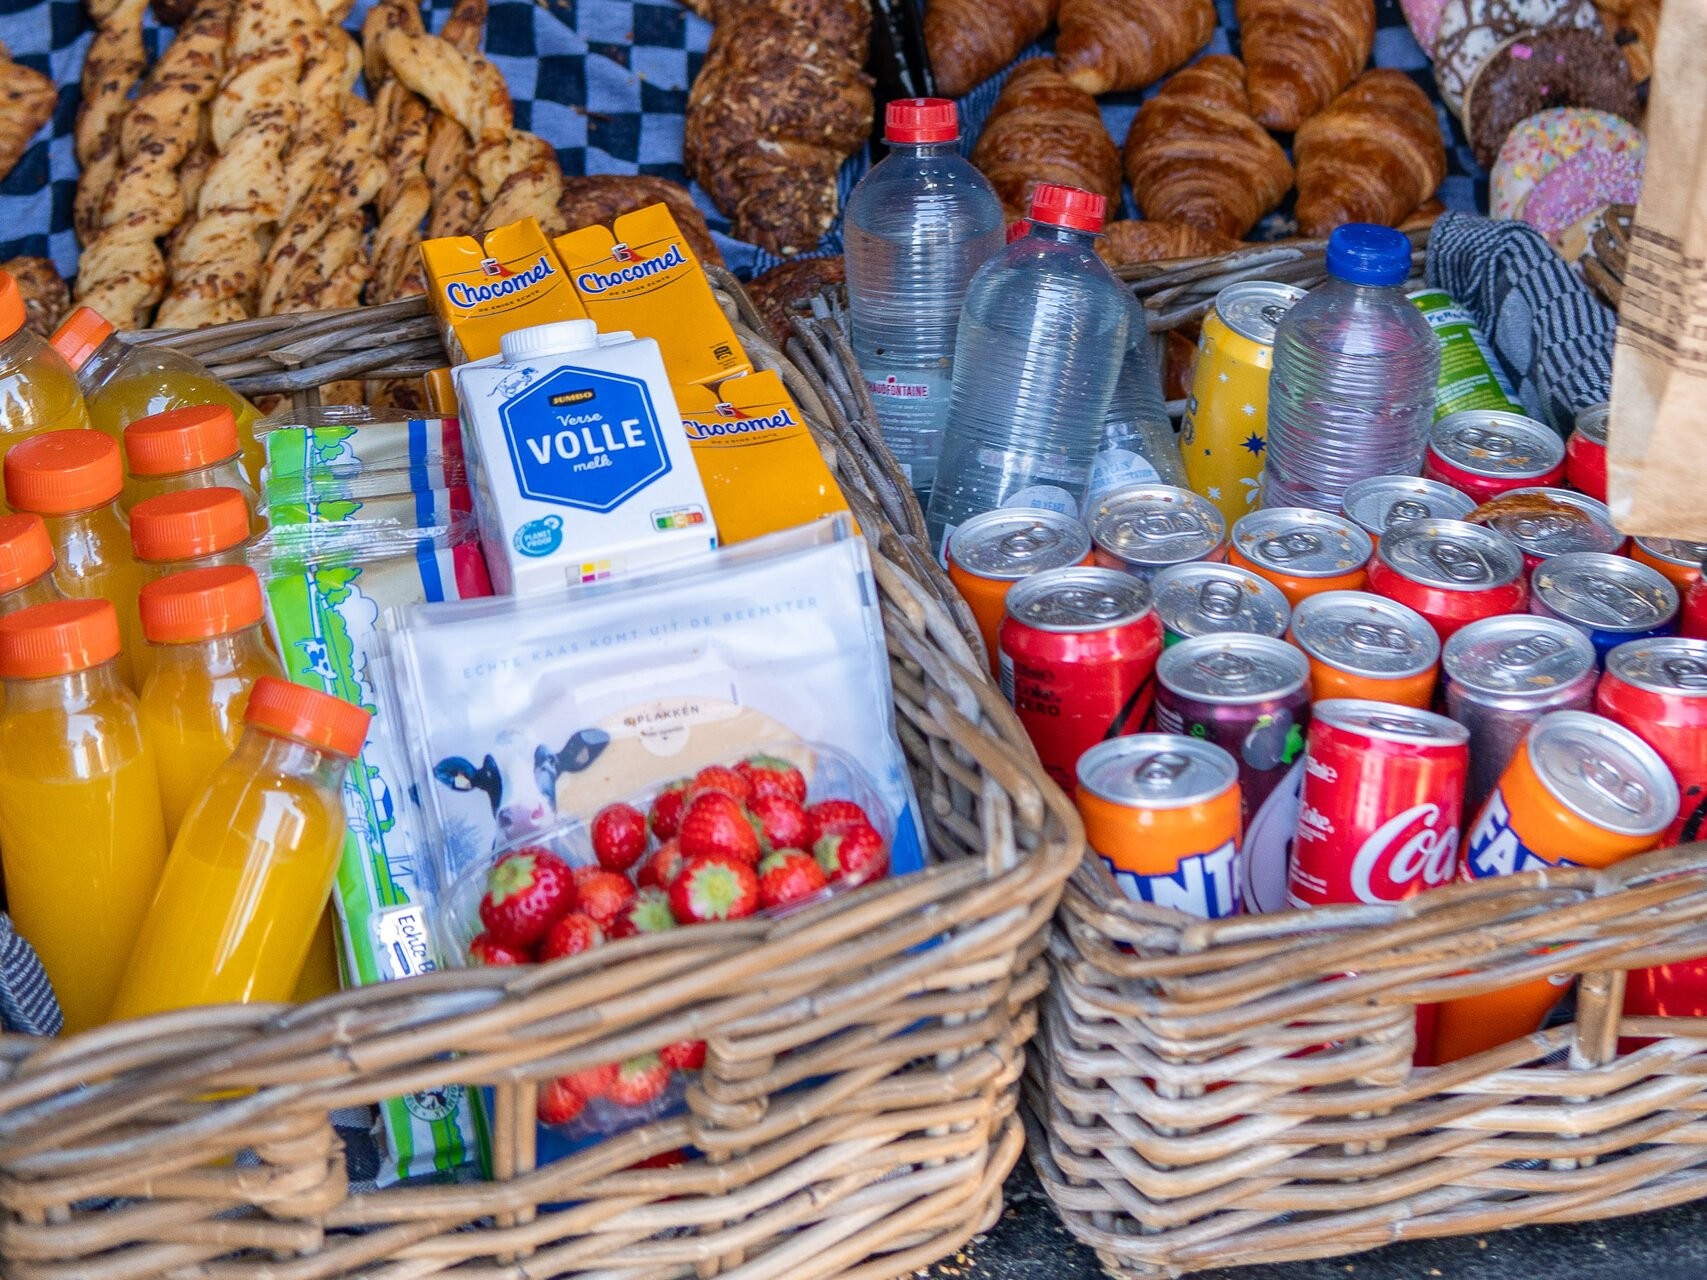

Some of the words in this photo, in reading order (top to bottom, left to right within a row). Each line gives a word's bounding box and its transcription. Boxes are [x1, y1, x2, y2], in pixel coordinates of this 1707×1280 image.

[446, 255, 556, 308] Chocomel
[577, 244, 688, 294] Chocomel
[552, 390, 595, 406] JUMBO
[555, 411, 604, 428] Verse
[682, 408, 798, 441] Chocomel
[525, 418, 647, 466] VOLLE
[572, 452, 614, 473] melk
[463, 657, 522, 680] ECHTE
[532, 640, 580, 661] KAAS
[590, 628, 639, 649] KOMT
[649, 622, 678, 636] UIT
[690, 615, 712, 629] DE
[722, 596, 818, 624] BEEMSTER
[636, 704, 699, 724] PLAKKEN
[397, 914, 428, 958] Echte
[418, 959, 438, 974] B
